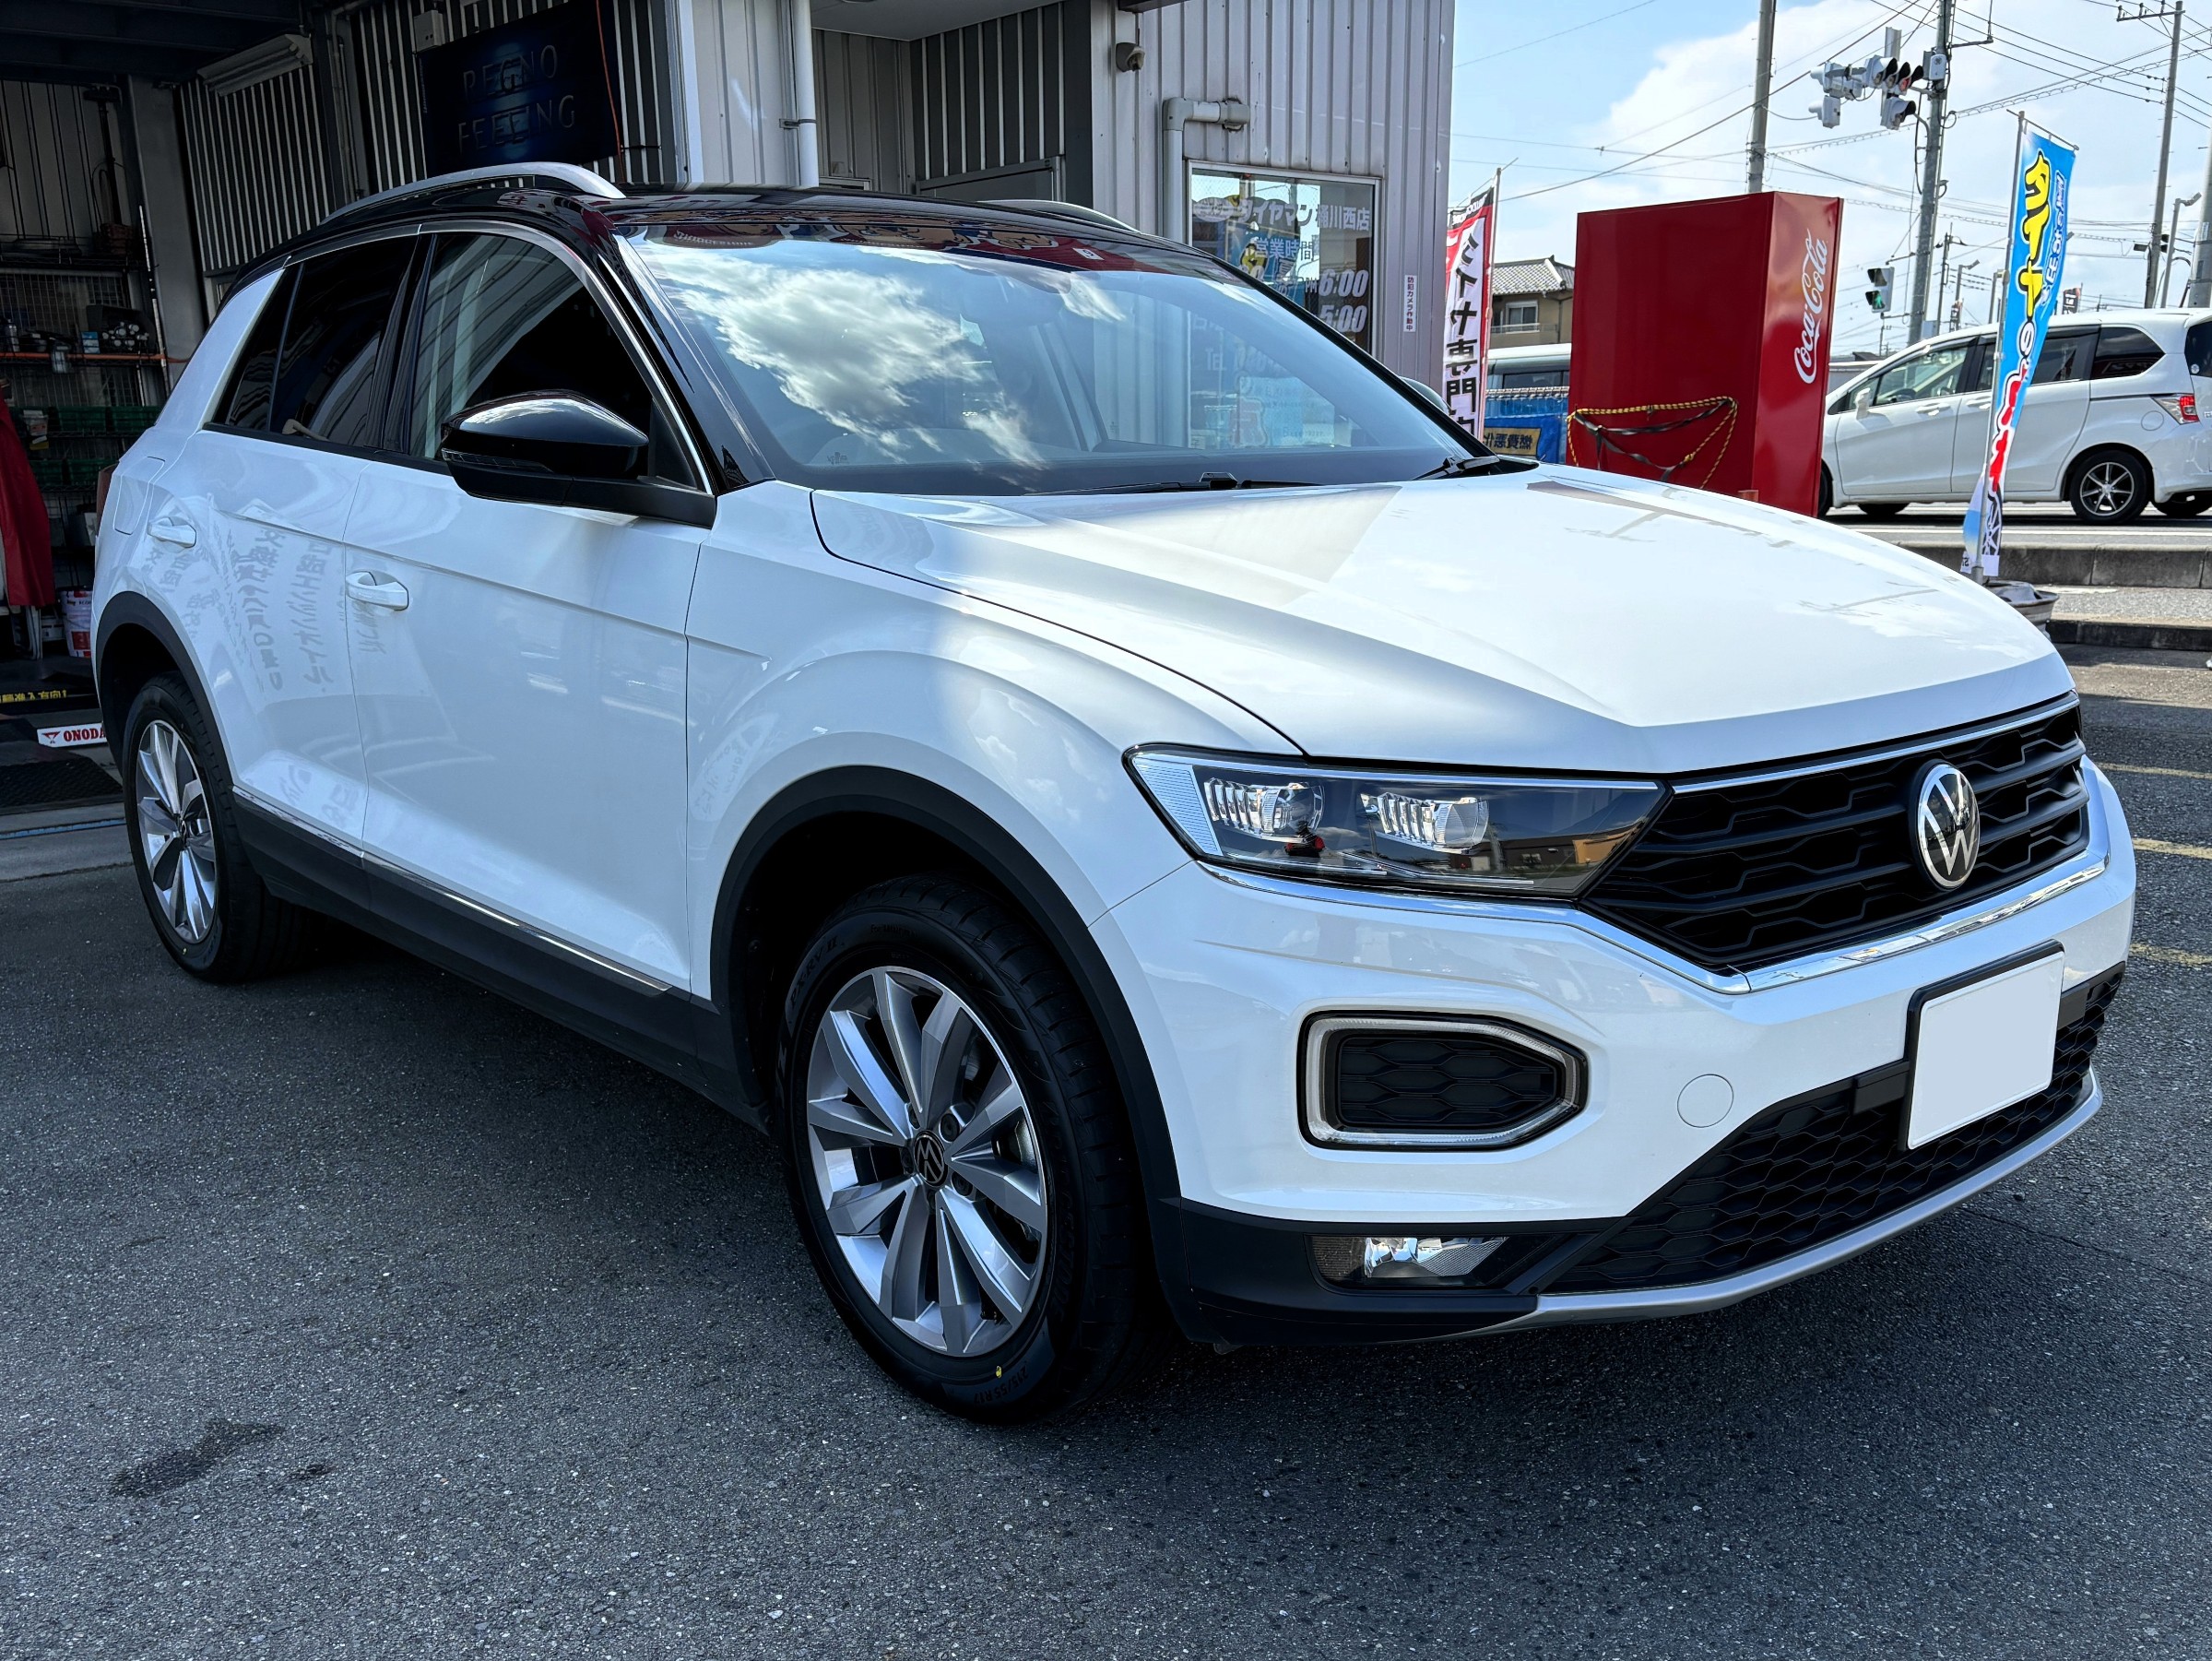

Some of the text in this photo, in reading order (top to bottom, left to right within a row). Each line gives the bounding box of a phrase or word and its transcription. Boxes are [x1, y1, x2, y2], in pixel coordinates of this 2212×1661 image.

[463, 44, 558, 104] REGNO
[457, 94, 575, 156] FEELING
[1256, 238, 1315, 261] 営業時間
[1319, 268, 1369, 298] 6:00
